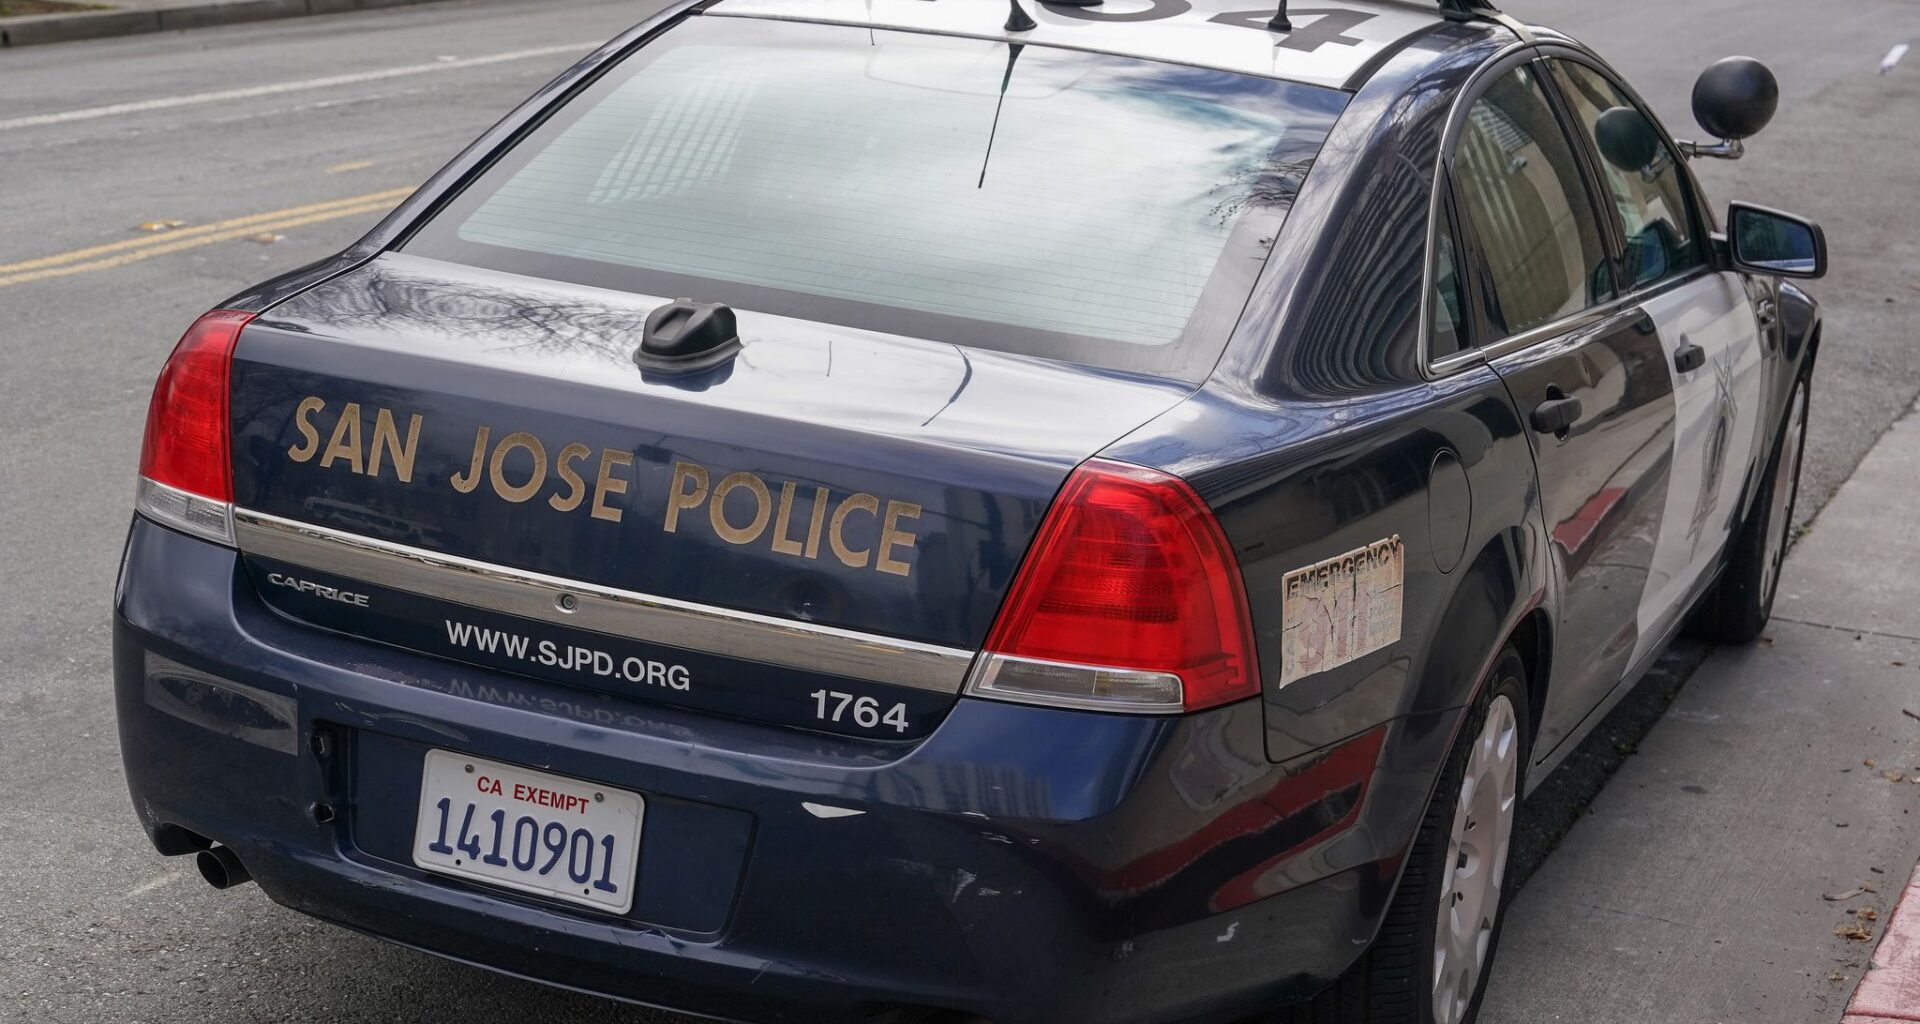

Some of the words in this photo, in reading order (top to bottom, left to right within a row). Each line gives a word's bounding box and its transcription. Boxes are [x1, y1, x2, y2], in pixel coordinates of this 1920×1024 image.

[288, 396, 423, 482] SAN
[450, 426, 634, 522] JOSE
[664, 461, 922, 576] POLICE
[267, 573, 370, 608] CAPRICE
[1286, 539, 1401, 600] EMERGENCY
[445, 620, 690, 691] WWW.SJPD.ORG
[811, 690, 909, 732] 1764
[477, 776, 503, 796] CA
[513, 784, 590, 814] EXEMPT
[428, 797, 617, 894] 1410901
